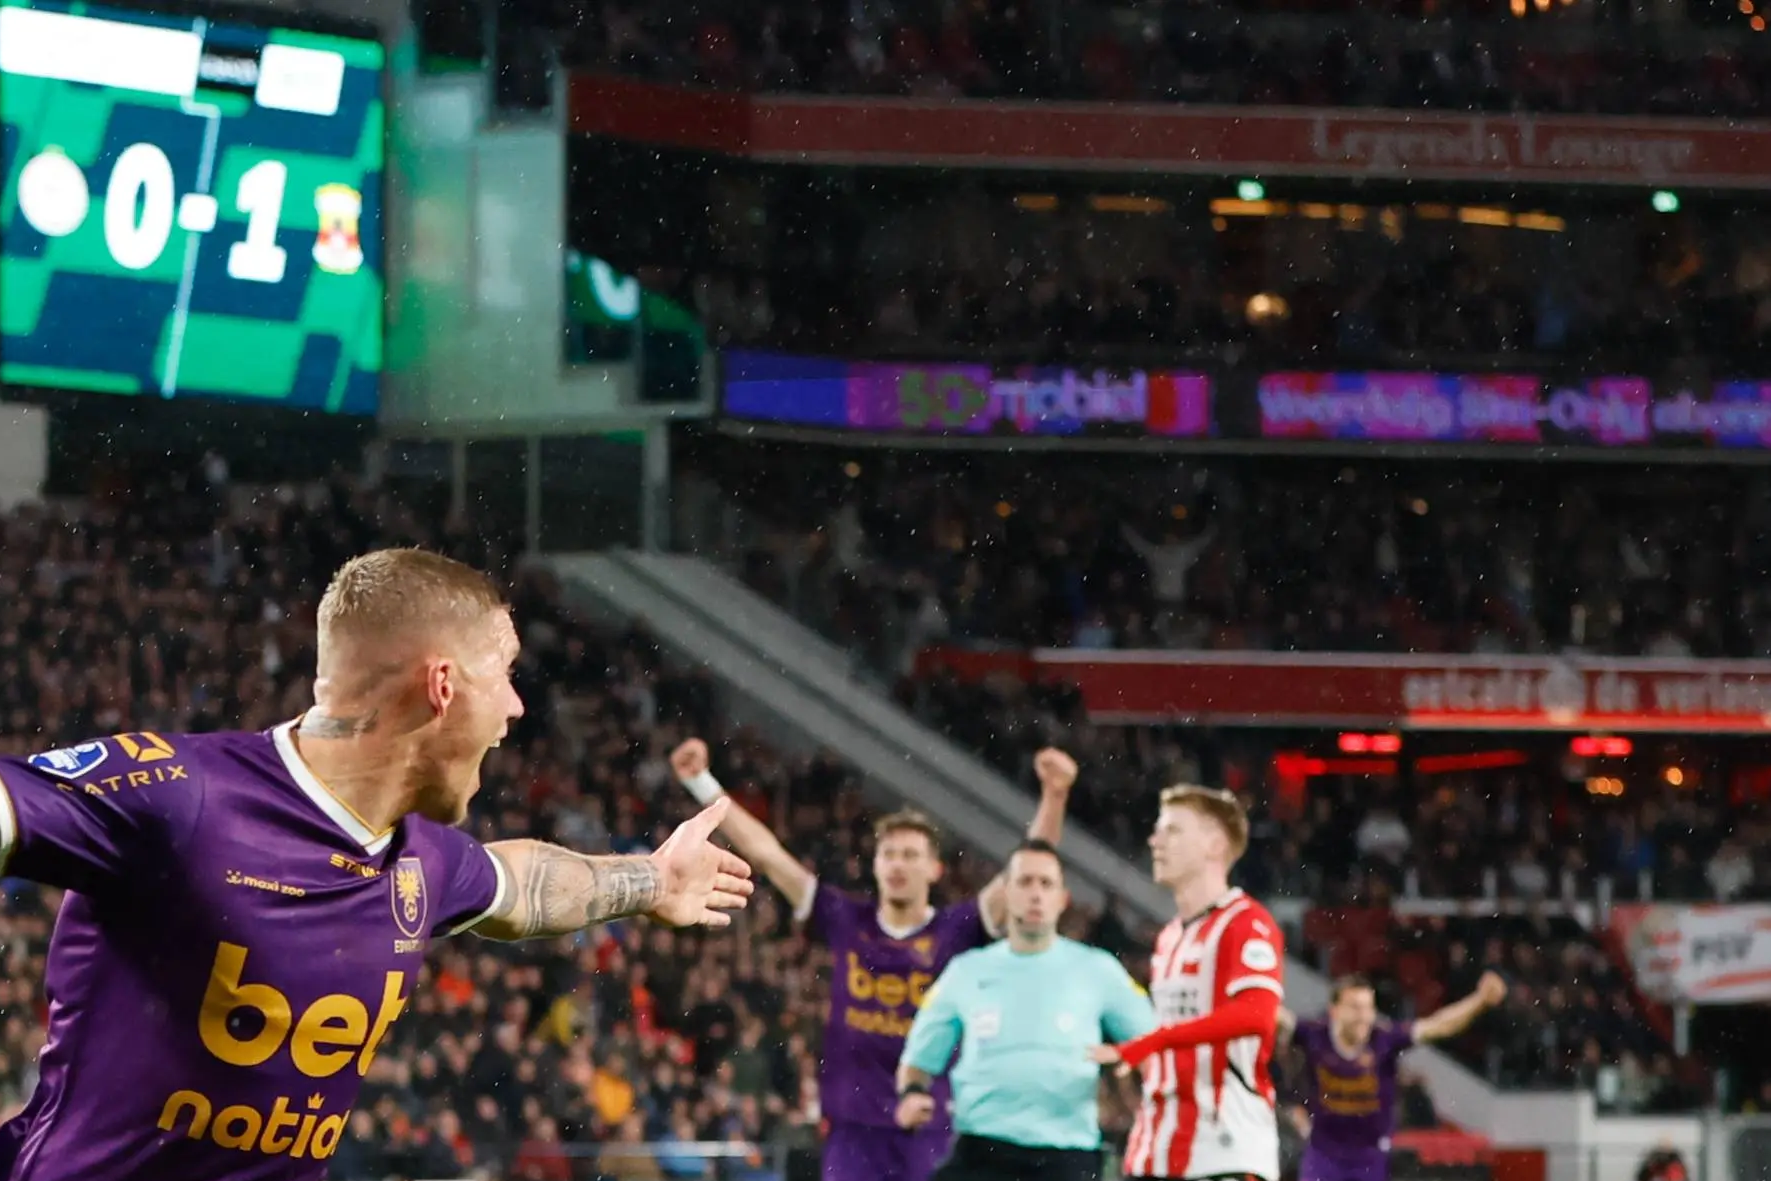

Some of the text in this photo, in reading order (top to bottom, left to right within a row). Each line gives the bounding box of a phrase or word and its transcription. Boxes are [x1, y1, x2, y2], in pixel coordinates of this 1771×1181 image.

[56, 765, 188, 796] ATRIX
[243, 875, 306, 898] maxi zoo
[198, 941, 408, 1078] bet
[157, 1090, 350, 1160] natio
